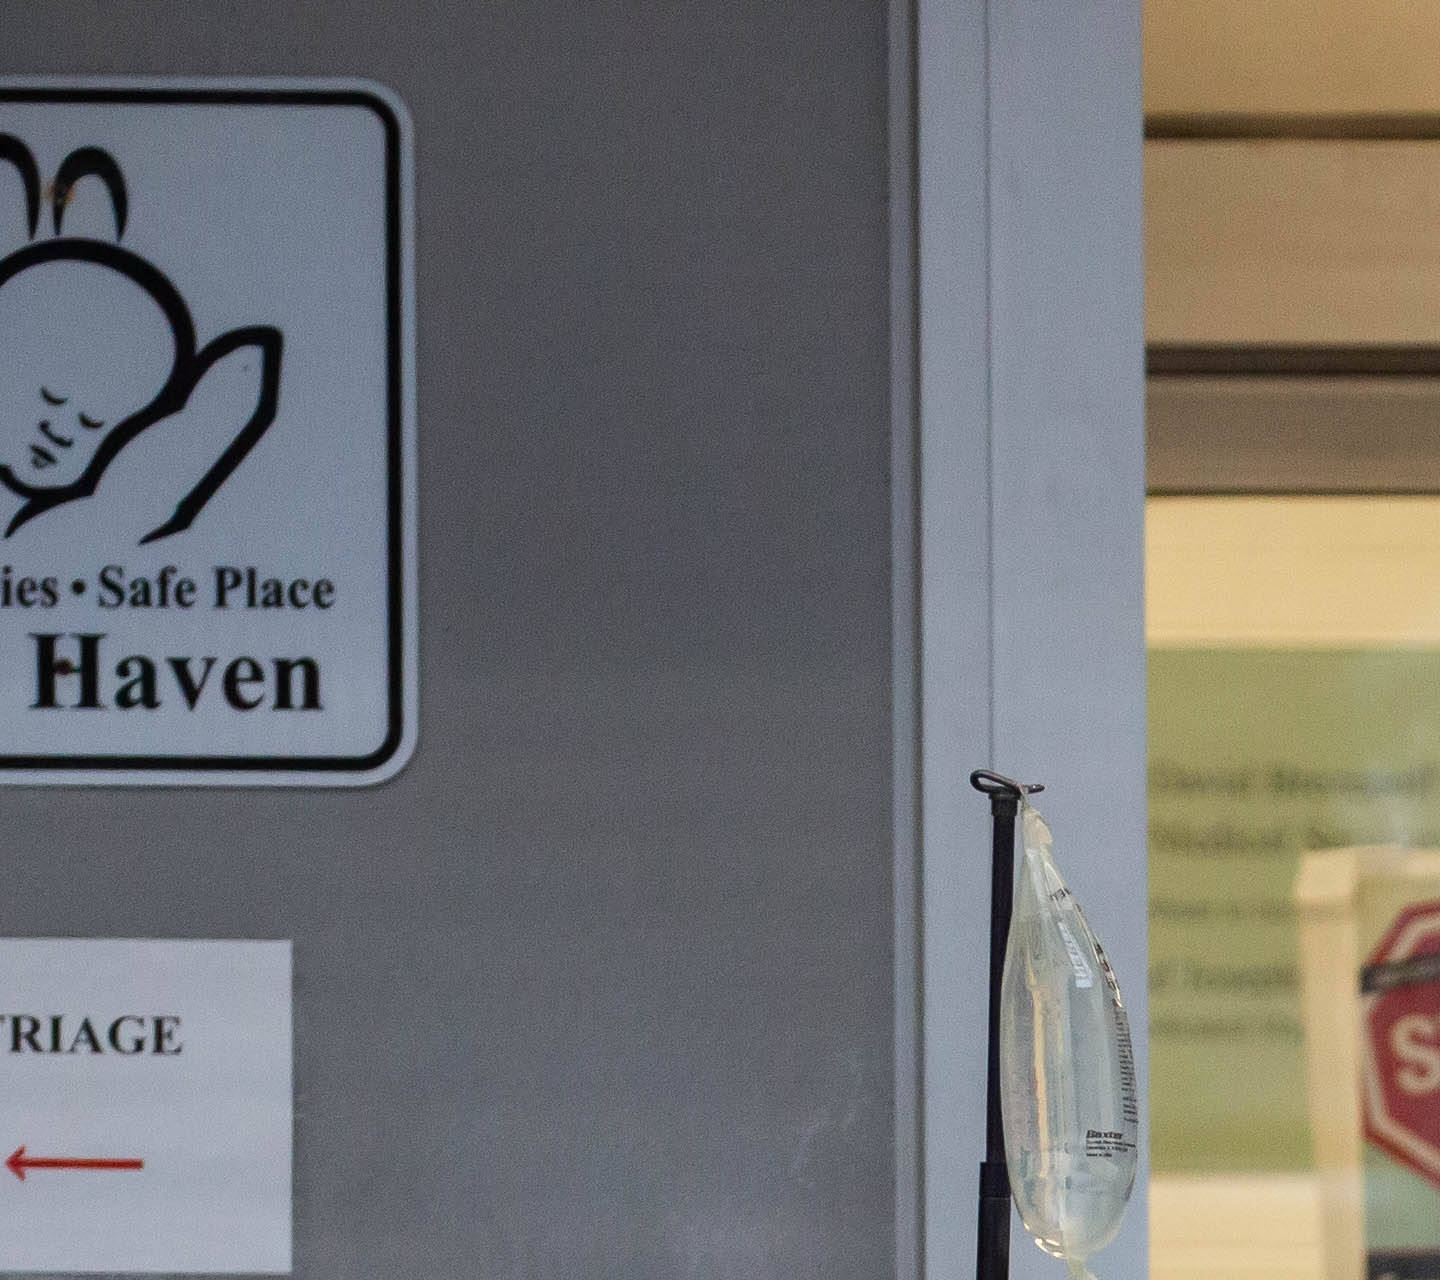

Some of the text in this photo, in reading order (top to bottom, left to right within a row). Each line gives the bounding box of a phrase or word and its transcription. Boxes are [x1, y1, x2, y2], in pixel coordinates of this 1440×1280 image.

[97, 566, 197, 609] Safe
[214, 567, 336, 610] Place
[30, 633, 324, 712] Haven
